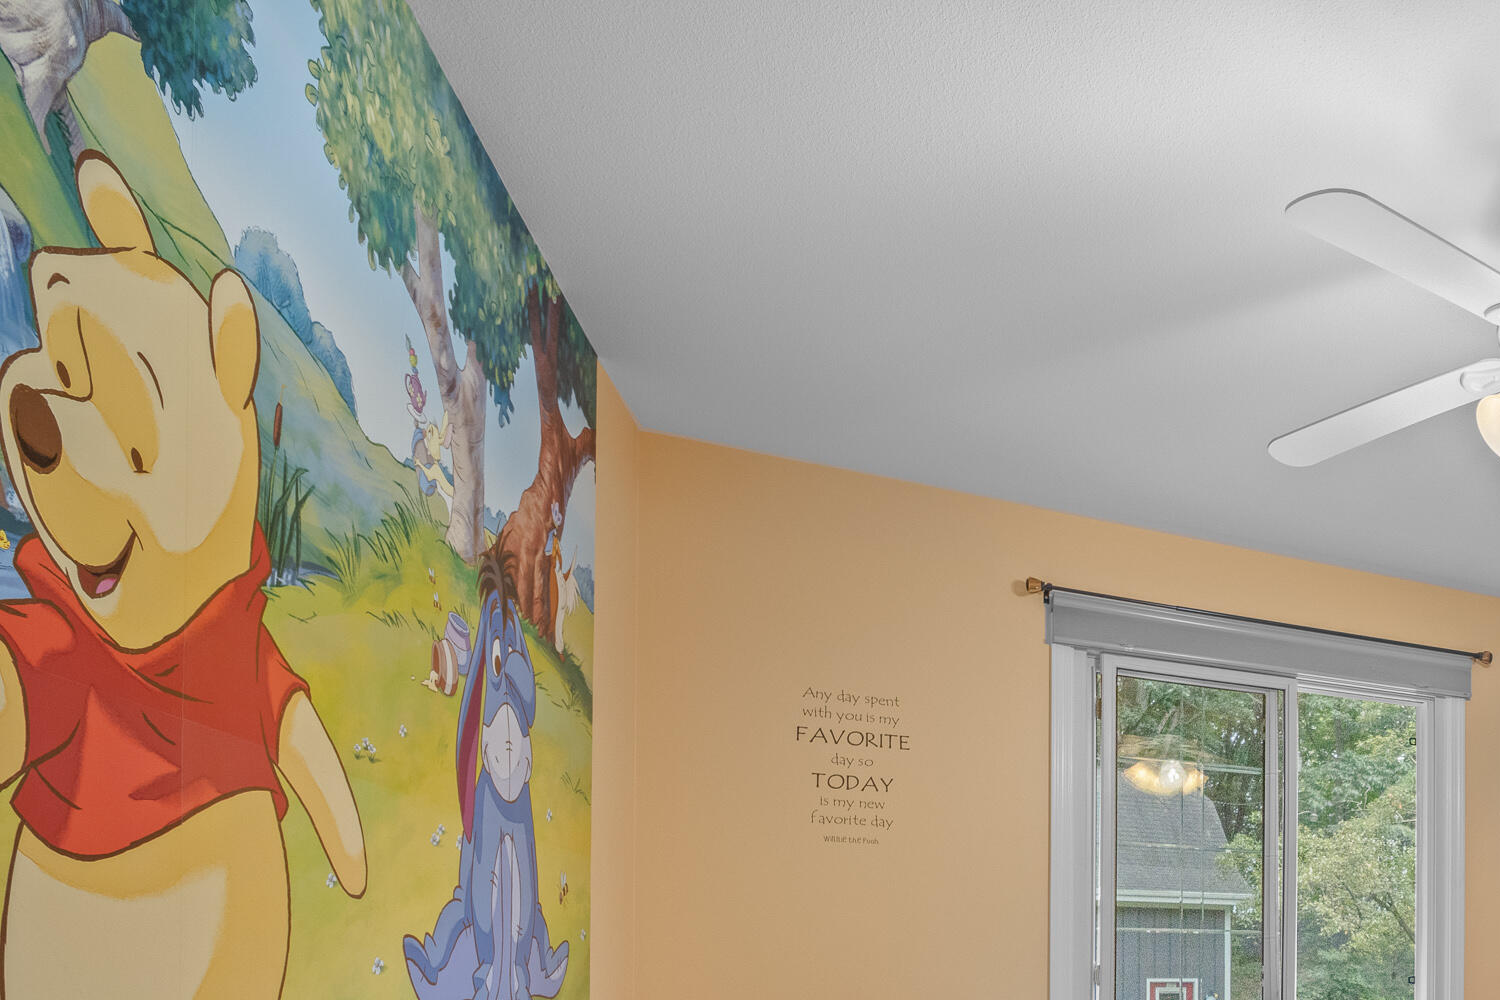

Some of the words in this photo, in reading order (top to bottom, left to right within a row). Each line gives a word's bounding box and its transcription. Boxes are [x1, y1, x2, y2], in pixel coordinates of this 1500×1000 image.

[802, 687, 832, 703] Any
[836, 689, 860, 704] day
[864, 696, 900, 708] spent
[802, 705, 832, 719] with
[836, 711, 863, 724] you
[866, 714, 876, 723] is
[879, 716, 900, 729] my
[796, 725, 911, 751] FAVORITE
[831, 752, 854, 769] day
[858, 757, 874, 767] so
[811, 772, 894, 793] TODAY
[820, 796, 829, 806] is
[833, 798, 855, 811] my
[859, 799, 885, 809] new
[811, 809, 867, 826] favorite
[870, 814, 894, 831] day
